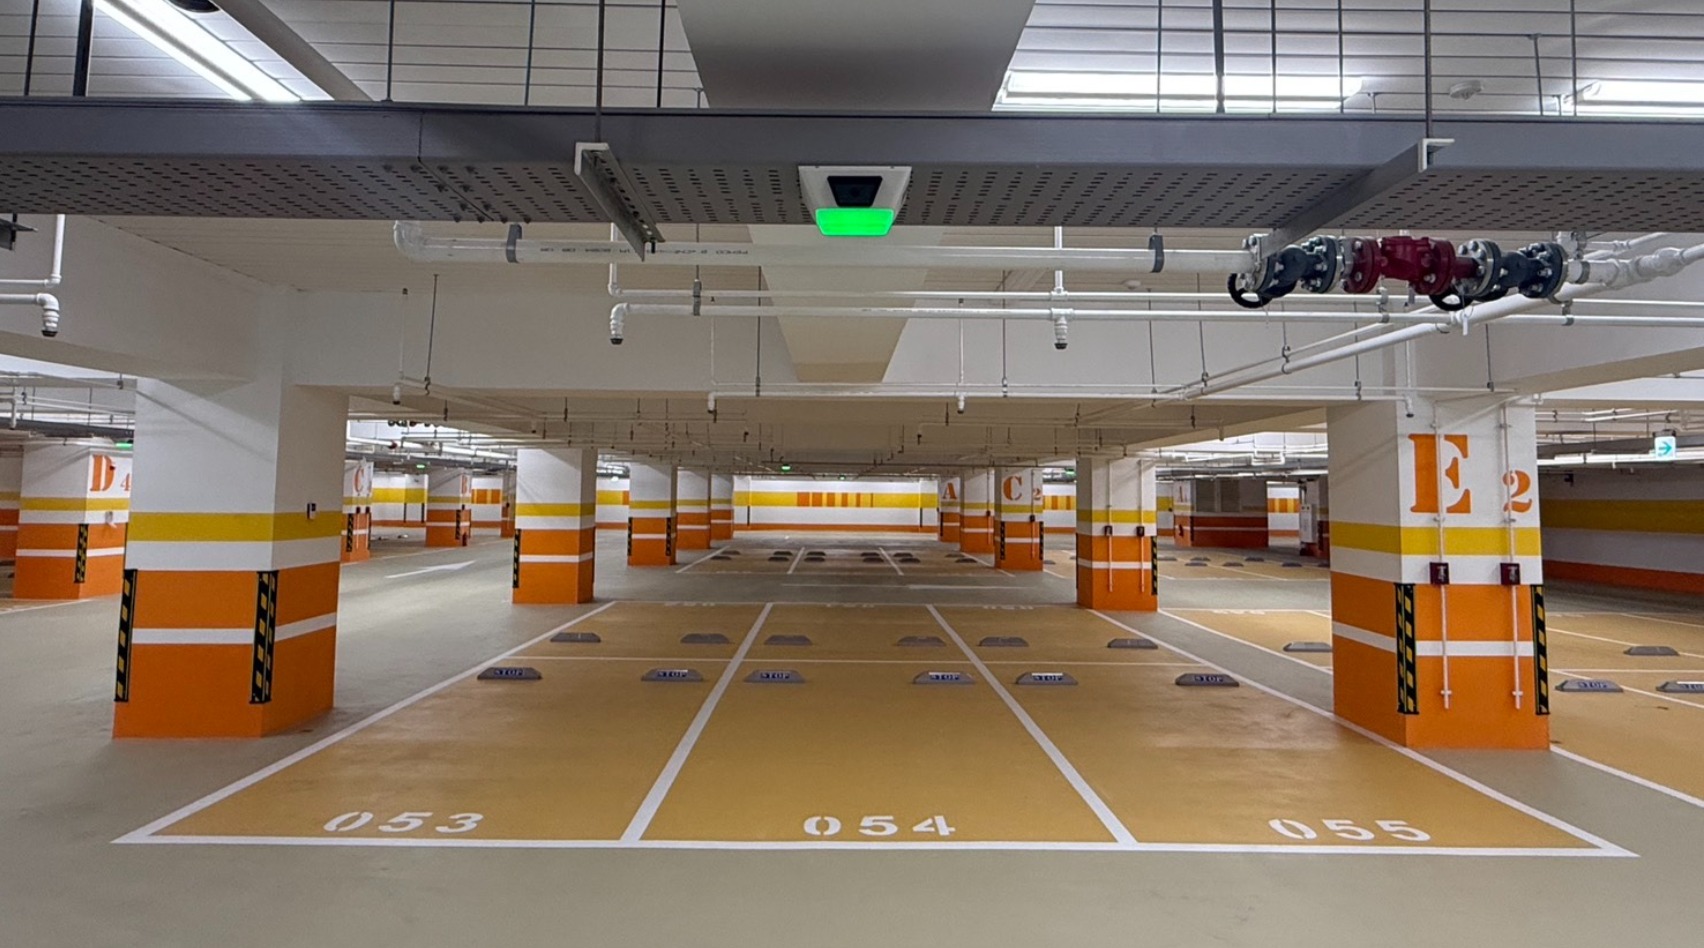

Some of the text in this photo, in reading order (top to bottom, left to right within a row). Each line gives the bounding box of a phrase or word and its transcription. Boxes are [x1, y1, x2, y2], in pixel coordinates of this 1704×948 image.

[90, 454, 130, 491] D 4
[1408, 434, 1533, 514] E 2
[943, 482, 957, 499] A
[1003, 476, 1022, 500] C
[494, 669, 524, 677] STOP
[760, 671, 790, 679] STOP
[1194, 675, 1224, 683] STOP
[323, 811, 484, 833] 053
[803, 815, 956, 836] 054
[1268, 818, 1431, 841] 055
